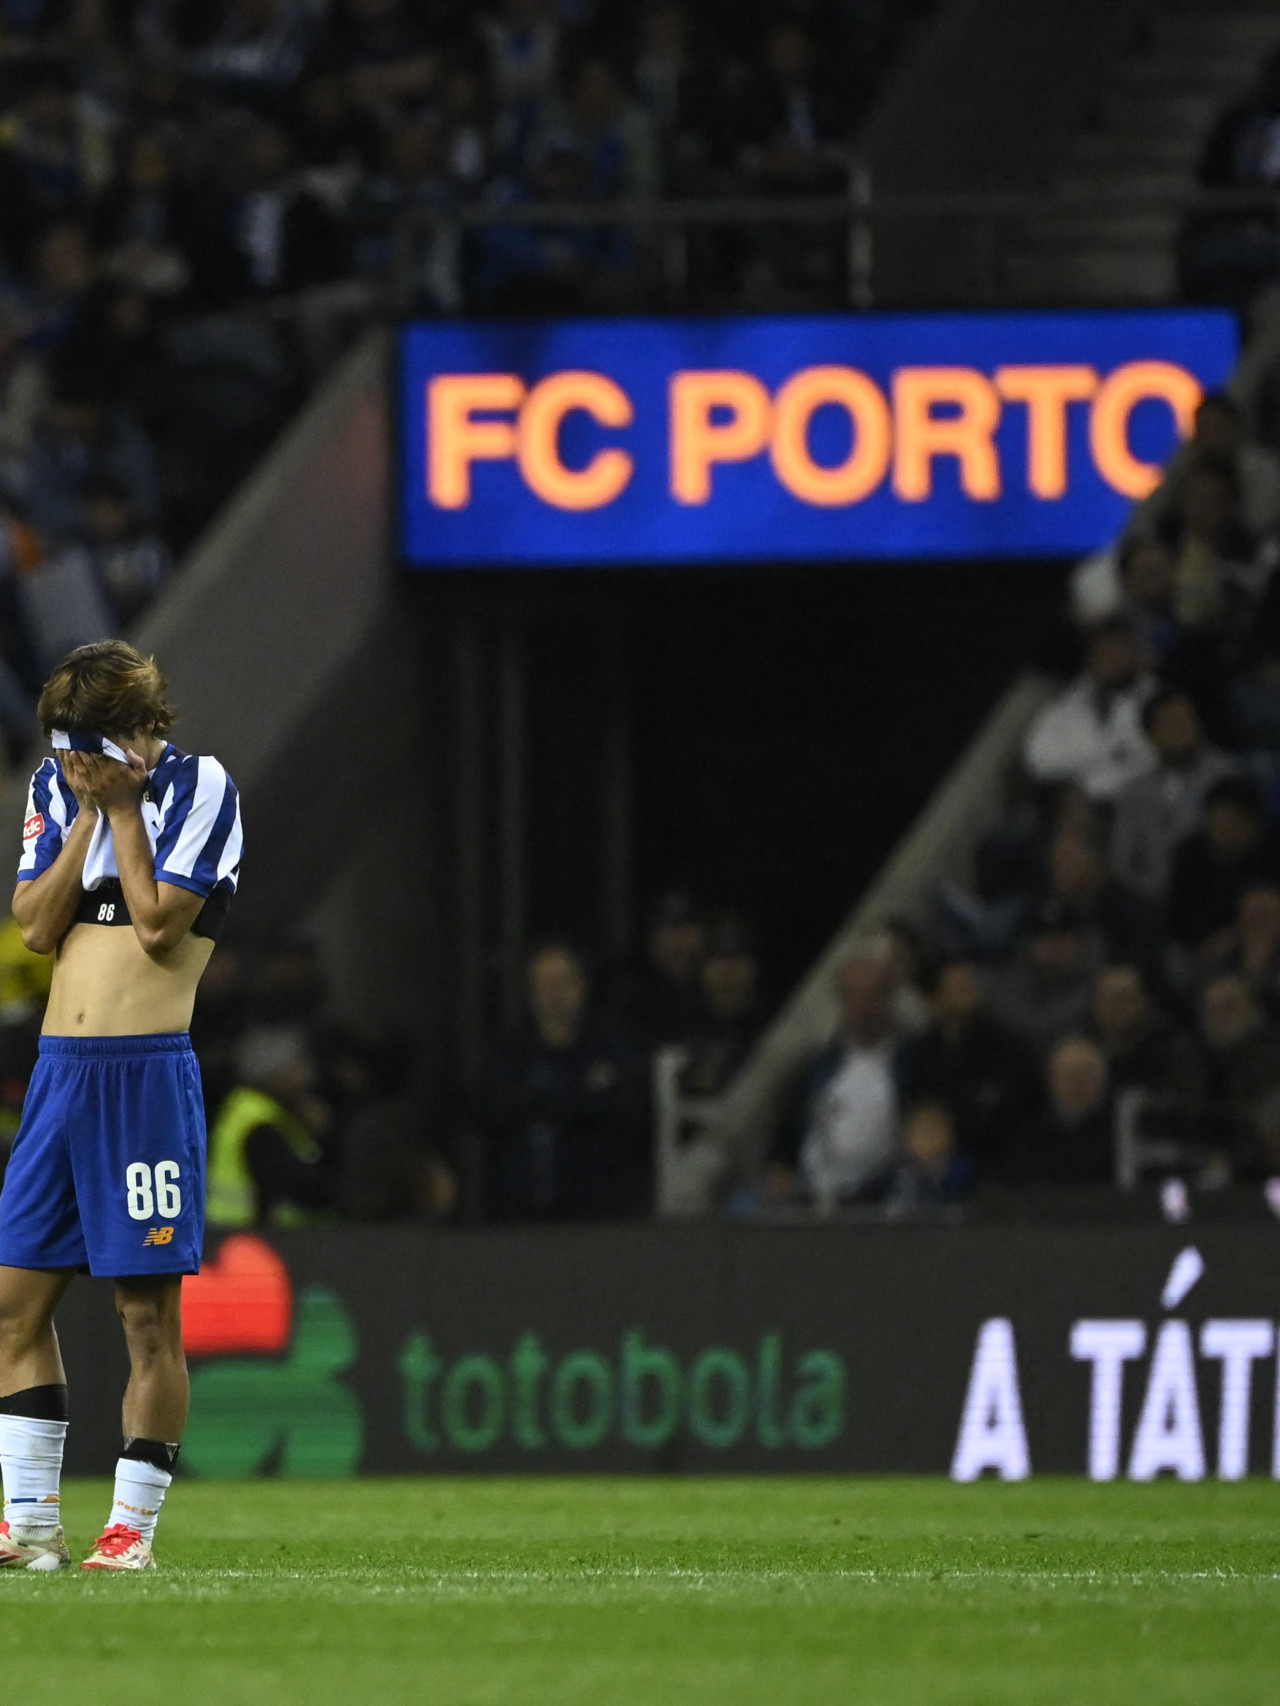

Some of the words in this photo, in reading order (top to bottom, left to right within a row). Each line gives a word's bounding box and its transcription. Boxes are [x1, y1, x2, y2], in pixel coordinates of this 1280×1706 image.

[426, 371, 633, 511] FC
[669, 359, 1203, 508] PORTO
[97, 903, 115, 921] 86
[126, 1160, 181, 1220] 86
[401, 1330, 847, 1451] totobola
[950, 1316, 1031, 1483] A
[1070, 1244, 1280, 1483] TÁT
